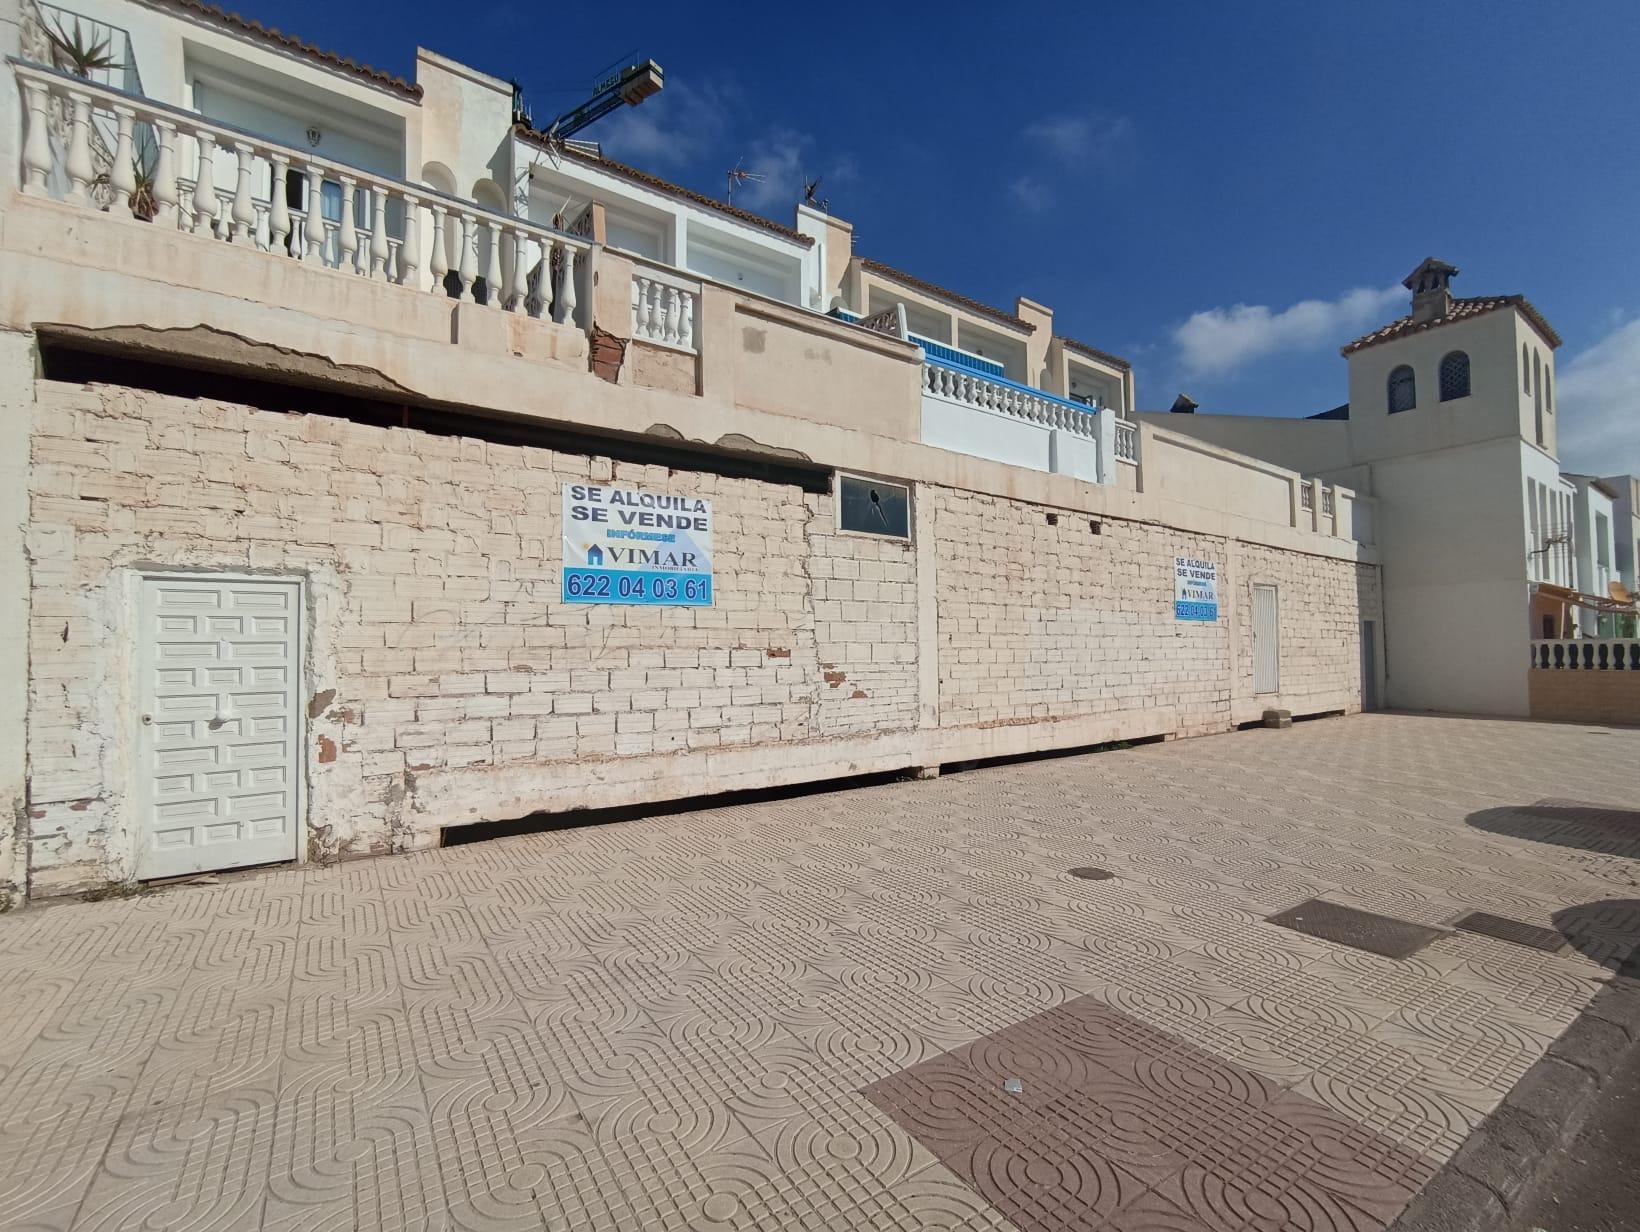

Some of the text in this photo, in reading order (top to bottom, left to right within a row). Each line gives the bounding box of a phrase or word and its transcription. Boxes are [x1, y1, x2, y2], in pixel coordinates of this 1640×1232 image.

[571, 485, 707, 514] SE ALQUILA
[571, 505, 708, 532] SE VENDE
[606, 546, 698, 567] VIMAR
[1175, 557, 1215, 570] SE ALQUILA
[1176, 568, 1216, 580] SE VENDE
[567, 574, 707, 600] 622 04 03 61
[1187, 589, 1214, 600] VIMAR
[1176, 604, 1189, 616] 622
